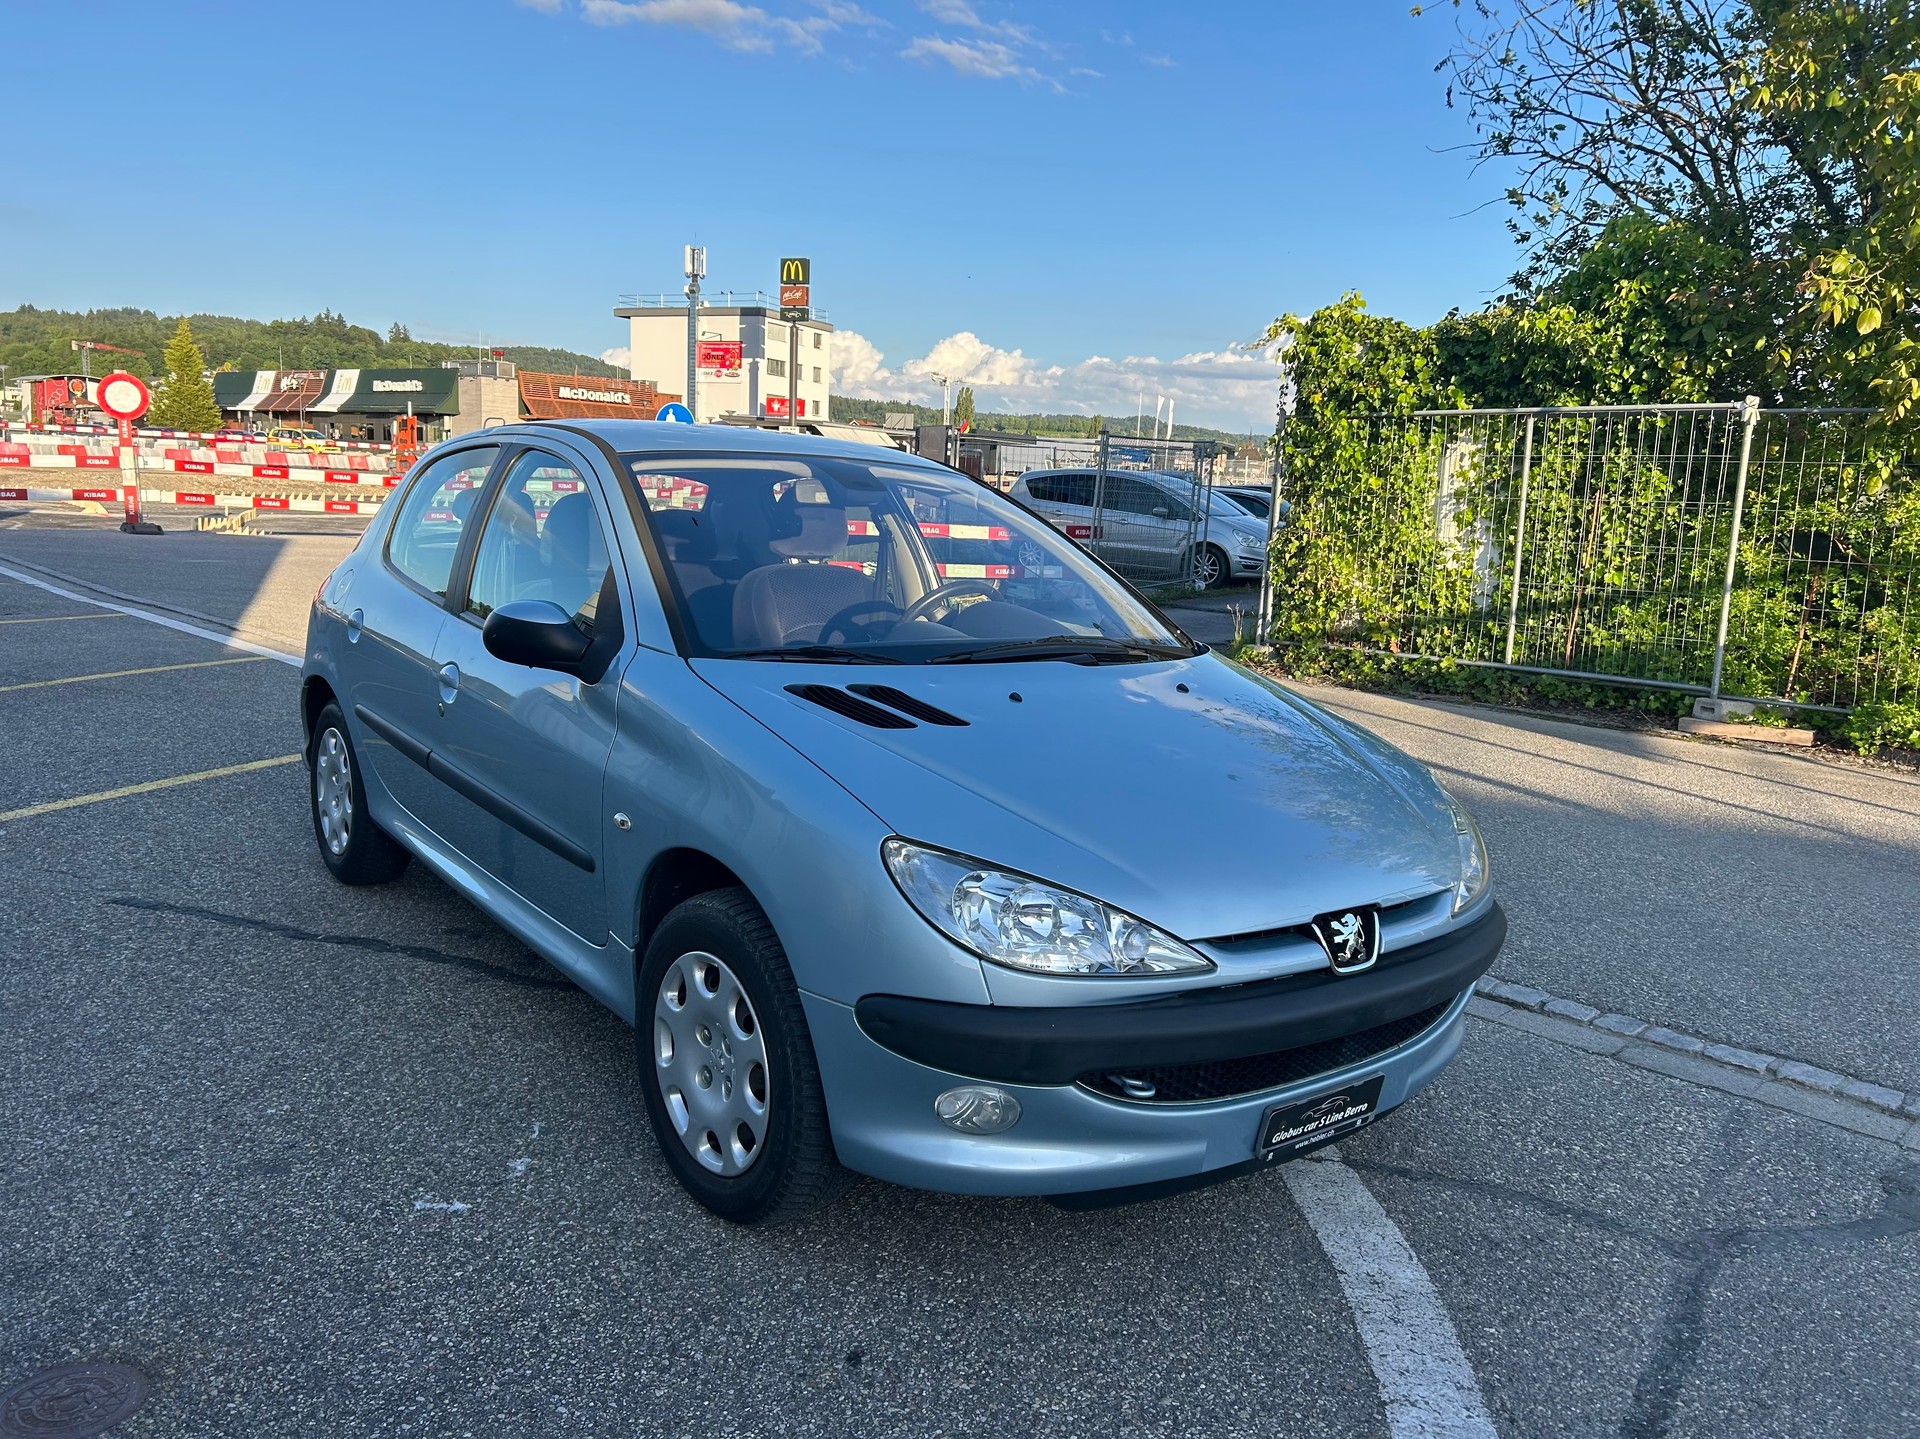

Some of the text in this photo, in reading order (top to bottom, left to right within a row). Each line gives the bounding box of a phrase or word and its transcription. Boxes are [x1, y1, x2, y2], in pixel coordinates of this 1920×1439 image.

[372, 379, 423, 393] McDonald's
[559, 386, 631, 404] McDonald's
[184, 463, 206, 471] KIBAG
[127, 496, 135, 515] KIBAG
[184, 495, 206, 503] KIBAG
[261, 499, 280, 507] KIBAG
[995, 567, 1015, 575] KIBAG
[1272, 1126, 1303, 1143] Globus
[1304, 1120, 1320, 1132] car
[1319, 1116, 1327, 1127] S
[1325, 1111, 1344, 1125] Line
[1344, 1103, 1368, 1118] Berro
